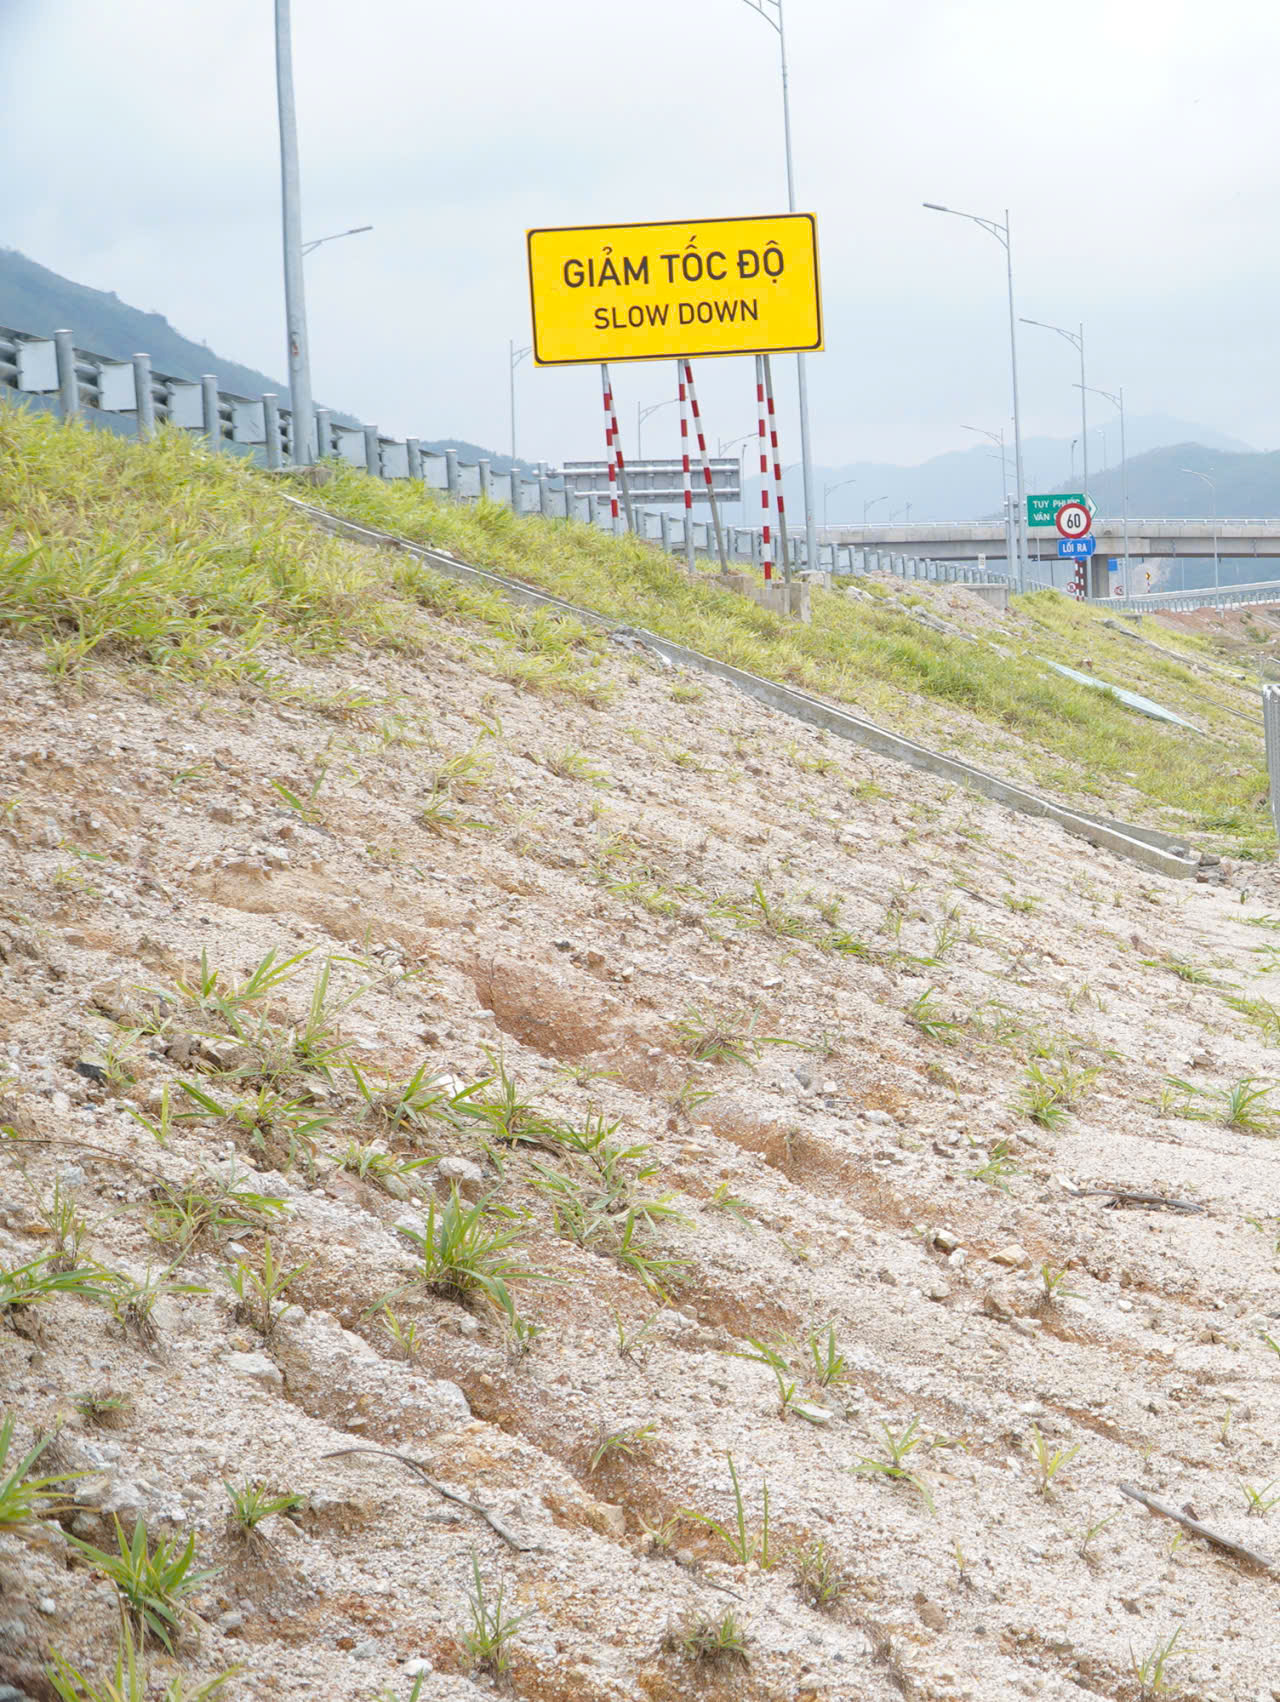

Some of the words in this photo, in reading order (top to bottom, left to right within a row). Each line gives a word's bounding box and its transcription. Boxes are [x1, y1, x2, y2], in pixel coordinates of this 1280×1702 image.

[563, 246, 649, 288] GIẢM
[660, 235, 728, 283] TỐC
[736, 240, 784, 284] ĐỘ
[594, 304, 669, 329] SLOW
[678, 299, 759, 324] DOWN
[1032, 500, 1050, 509] TUY
[1033, 511, 1050, 521] VÂN
[1067, 513, 1081, 529] 60
[1077, 543, 1088, 552] RA
